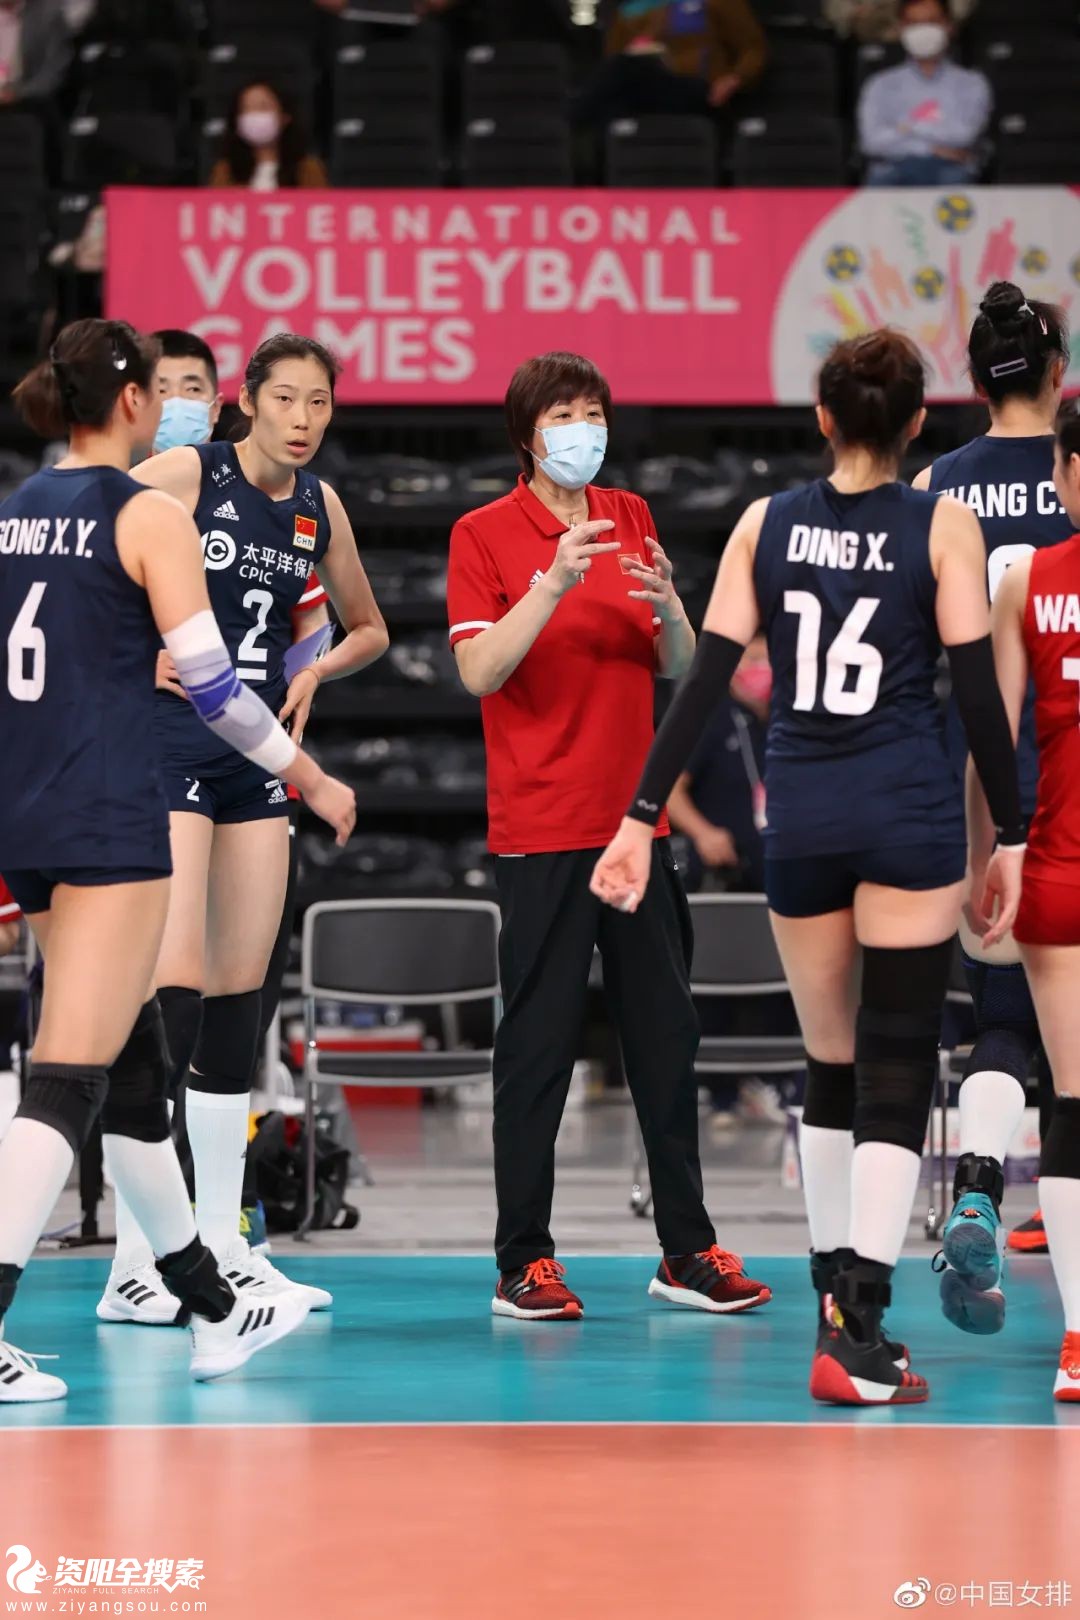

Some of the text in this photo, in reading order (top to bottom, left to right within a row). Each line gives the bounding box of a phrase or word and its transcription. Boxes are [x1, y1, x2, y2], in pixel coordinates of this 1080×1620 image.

[178, 202, 740, 244] INTERNATIONAL
[179, 246, 739, 312] VOLLEYBALL
[213, 510, 239, 521] adidas
[296, 536, 313, 546] CHN
[786, 524, 894, 571] DING X.
[239, 565, 273, 584] CPIC
[7, 581, 47, 702] 6
[238, 588, 273, 662] 2
[784, 590, 883, 716] 16
